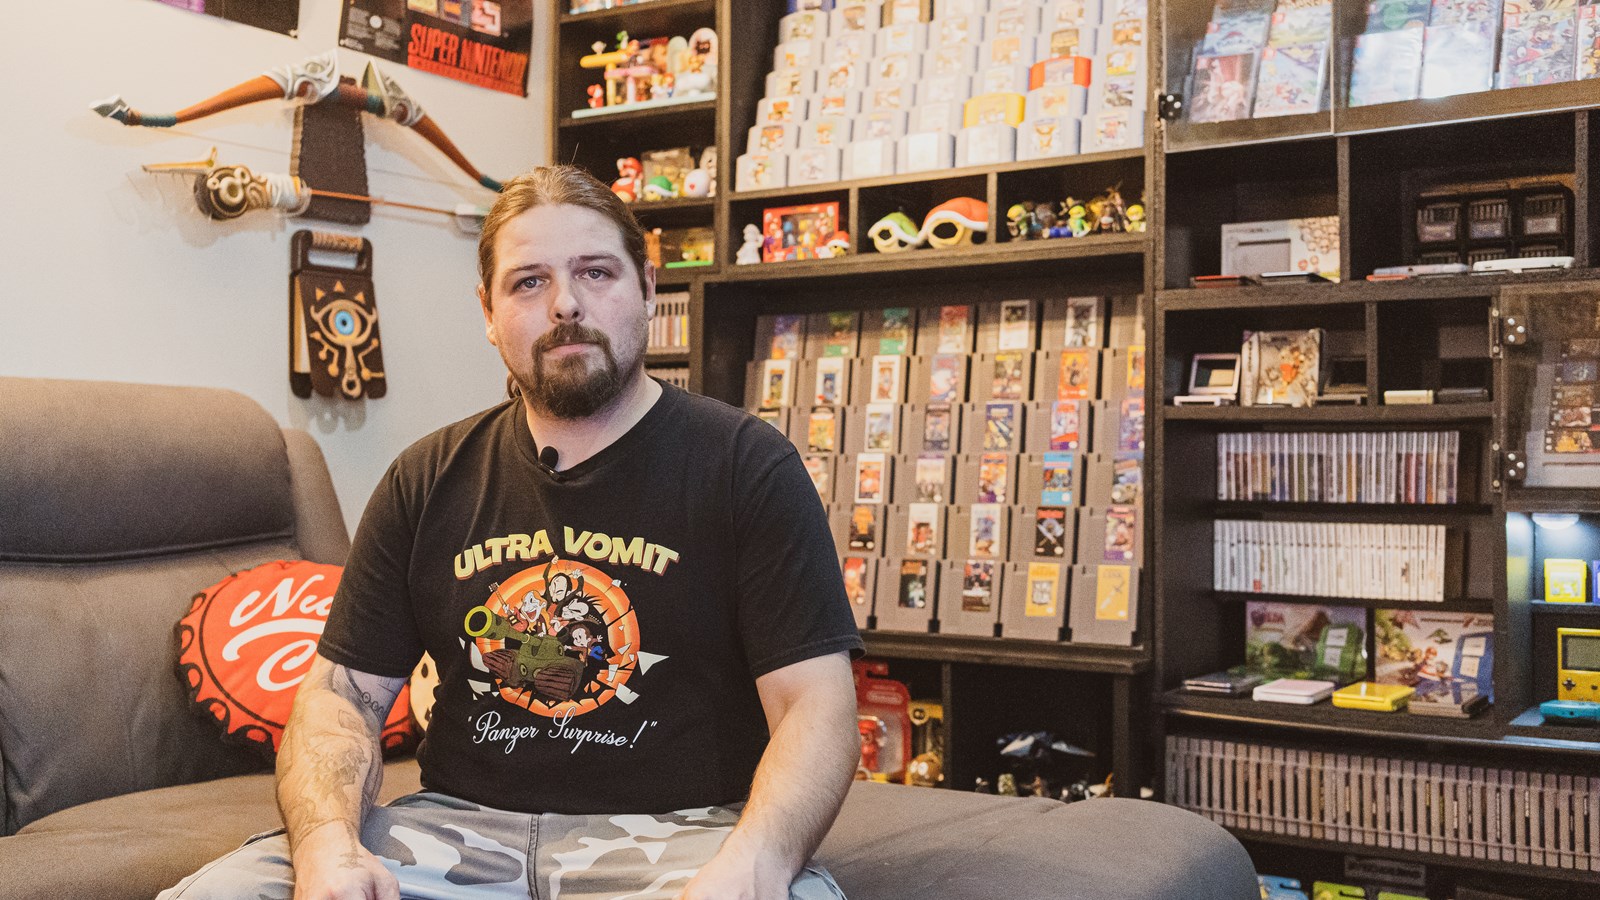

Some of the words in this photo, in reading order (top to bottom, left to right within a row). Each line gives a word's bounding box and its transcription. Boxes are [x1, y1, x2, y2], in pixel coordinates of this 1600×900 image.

[408, 23, 459, 66] SUPER
[454, 530, 555, 580] ULTRA
[563, 525, 680, 576] VOMIT
